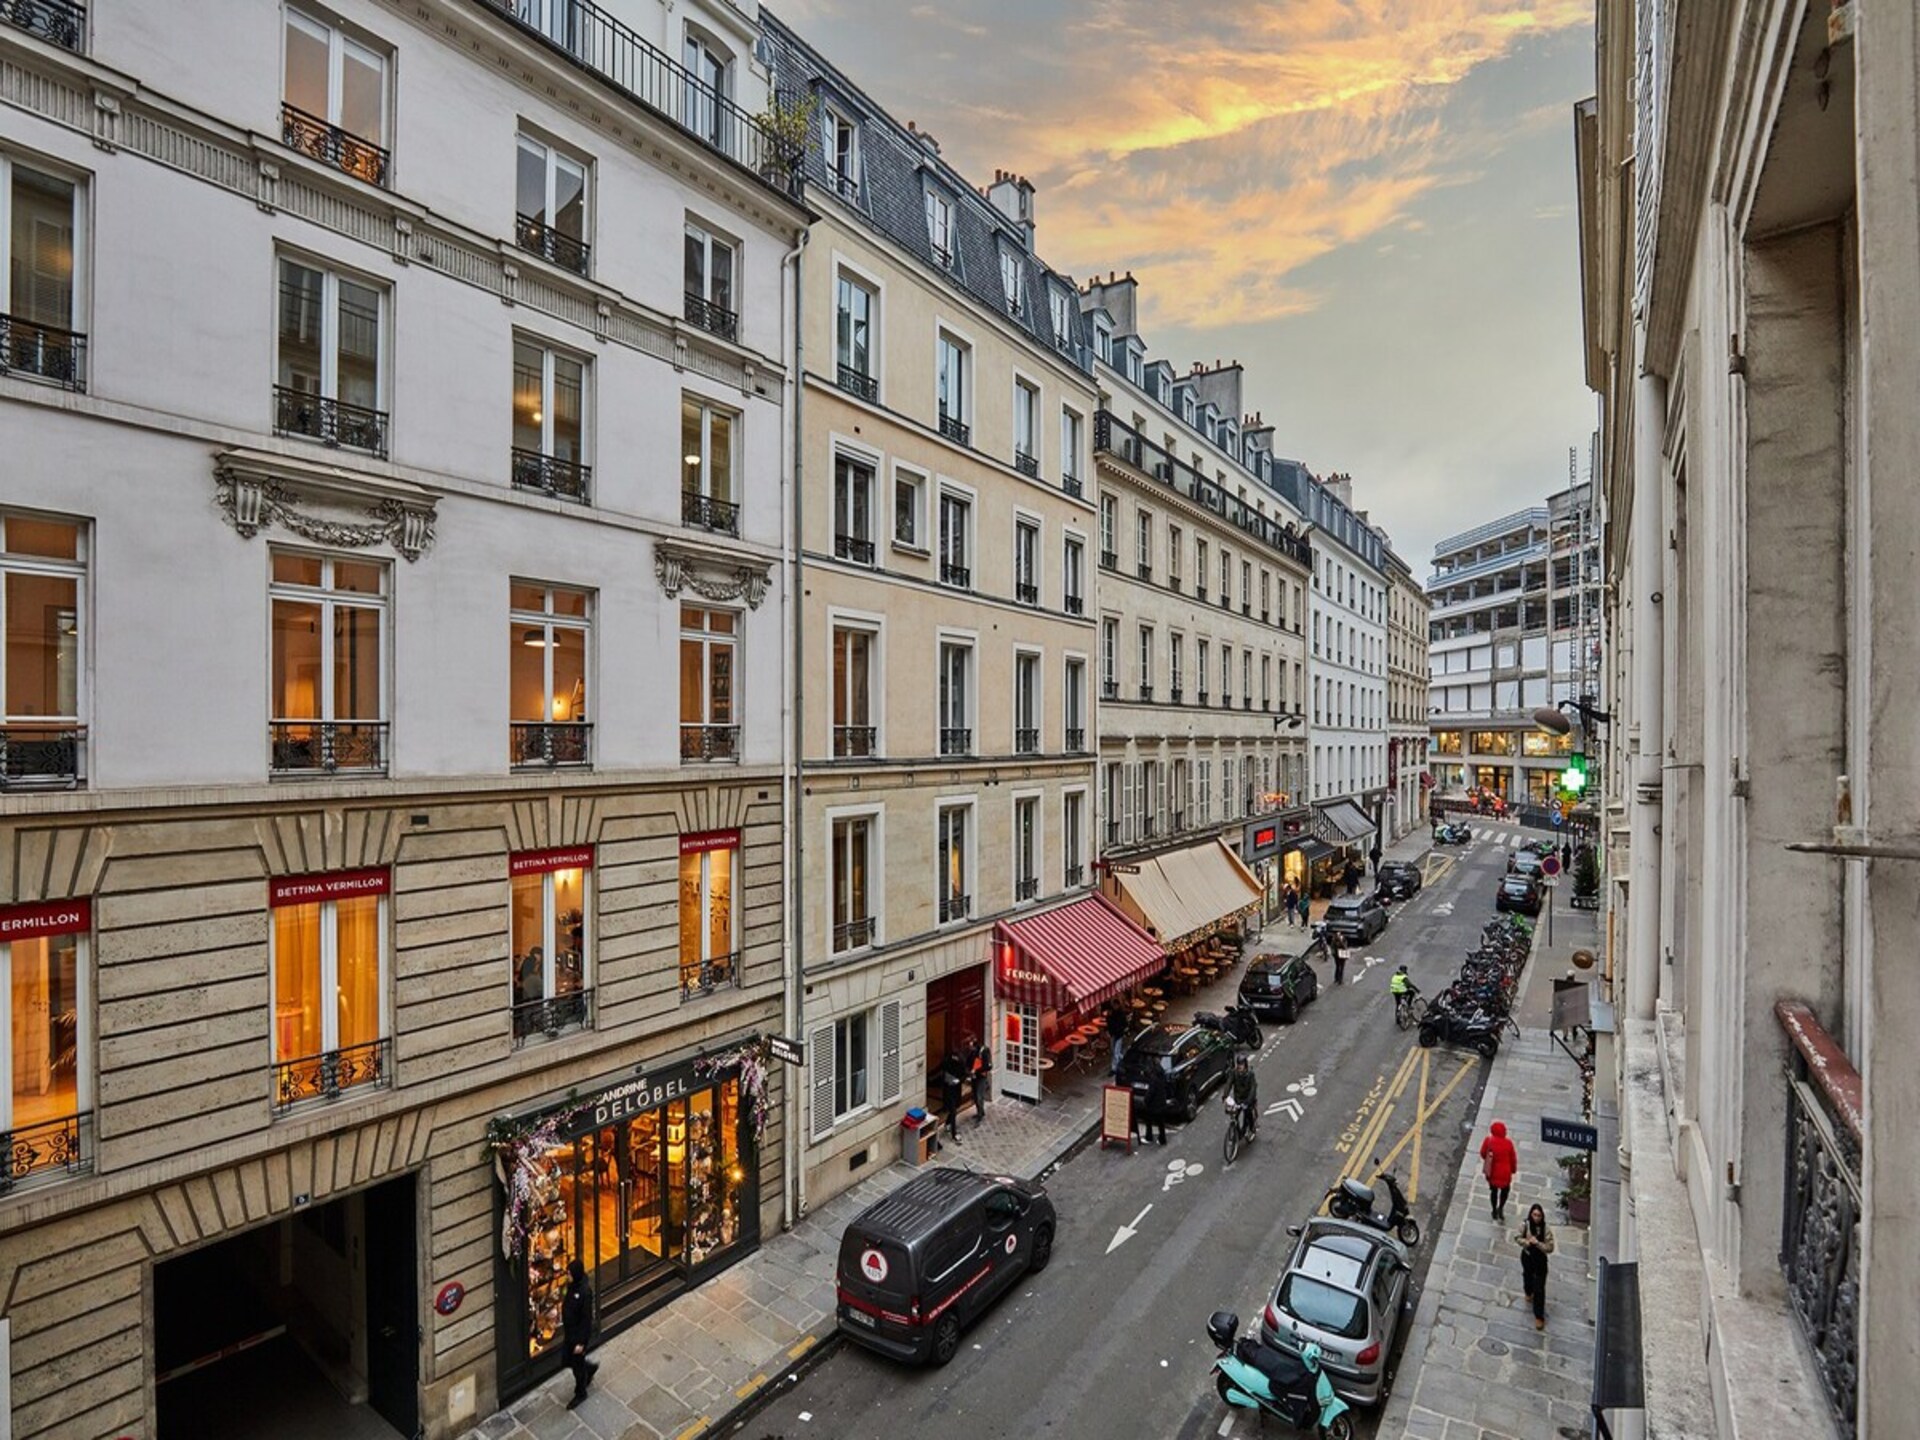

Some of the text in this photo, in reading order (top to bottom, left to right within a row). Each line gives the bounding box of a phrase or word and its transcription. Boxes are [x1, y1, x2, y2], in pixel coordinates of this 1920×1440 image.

[513, 854, 589, 870] BETTINA VERMILLON
[277, 878, 383, 897] BETTINA VERMILLON
[1, 913, 80, 931] ERMILLON
[595, 1078, 687, 1124] DELOBEL
[1545, 1128, 1594, 1144] BREUER
